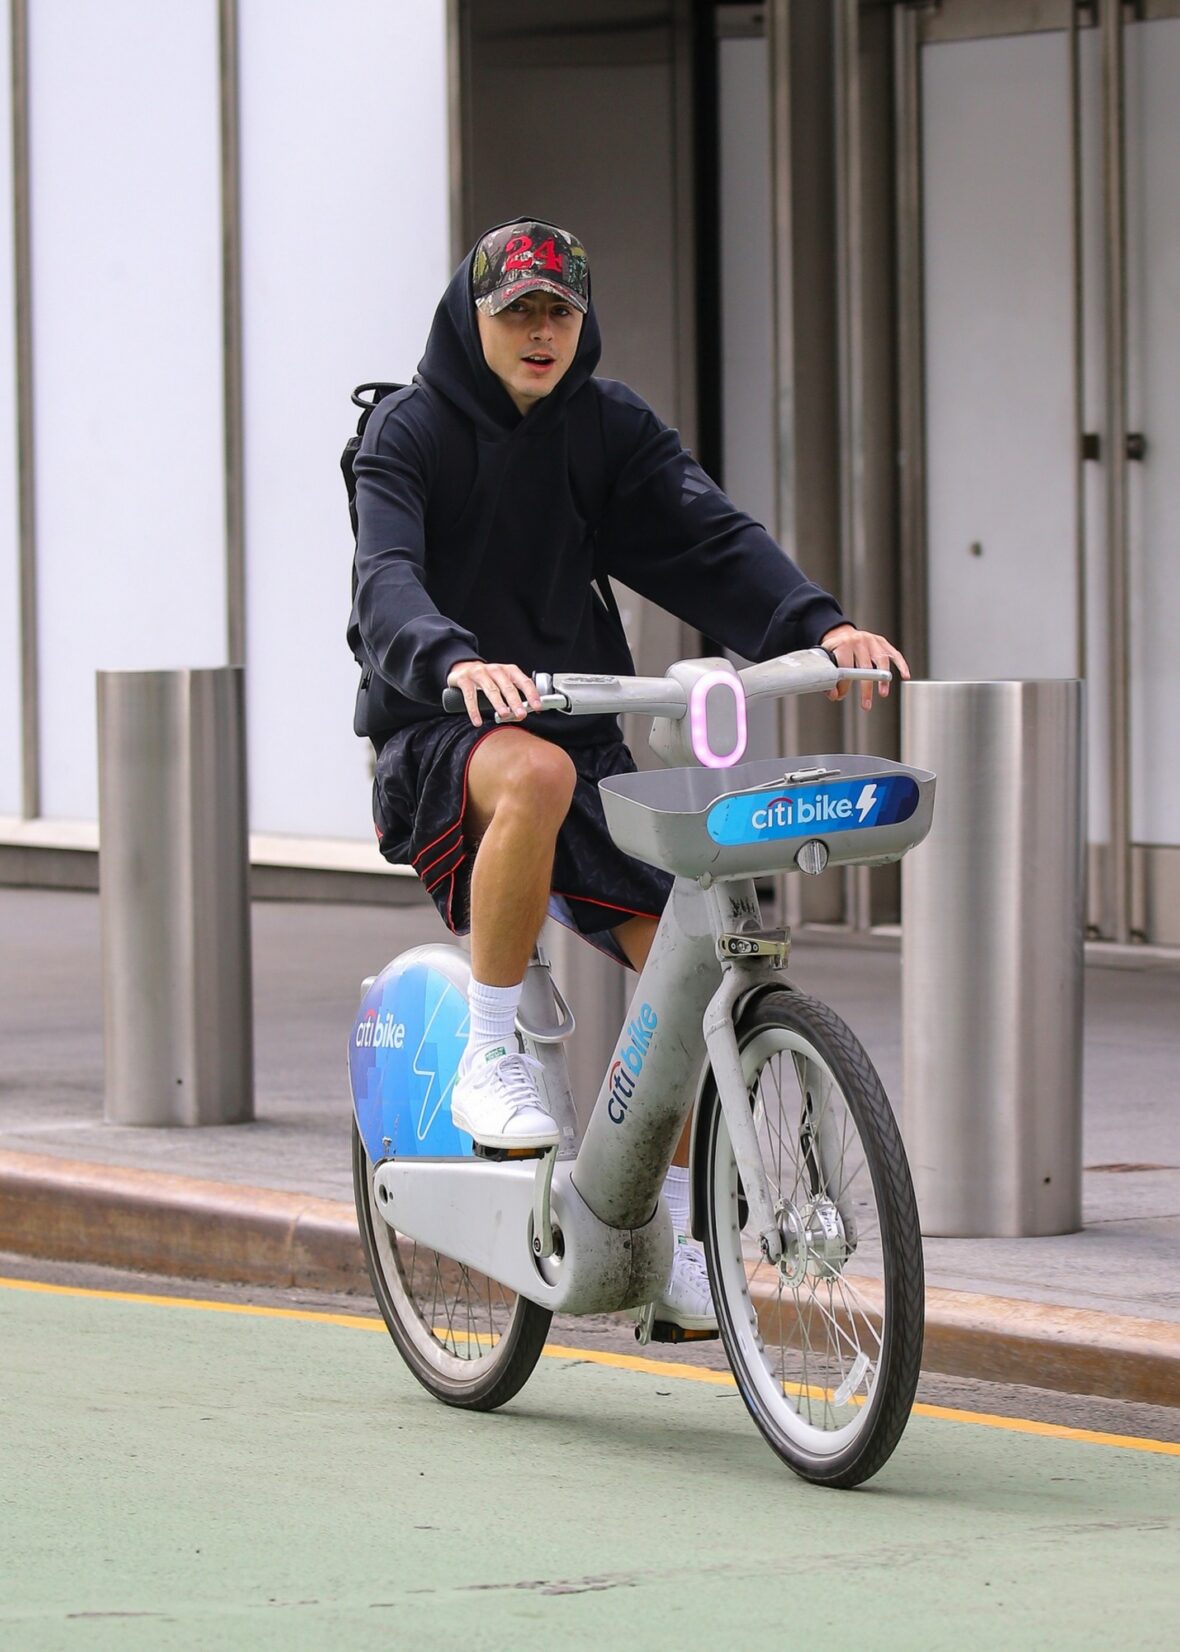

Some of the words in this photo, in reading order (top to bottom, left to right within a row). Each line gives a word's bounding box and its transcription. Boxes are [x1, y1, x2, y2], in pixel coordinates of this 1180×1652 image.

[505, 235, 563, 272] 24
[751, 797, 792, 830] citi
[797, 794, 853, 824] bike
[372, 1012, 406, 1049] bike
[619, 1002, 658, 1078] bike
[607, 1062, 635, 1125] citi
